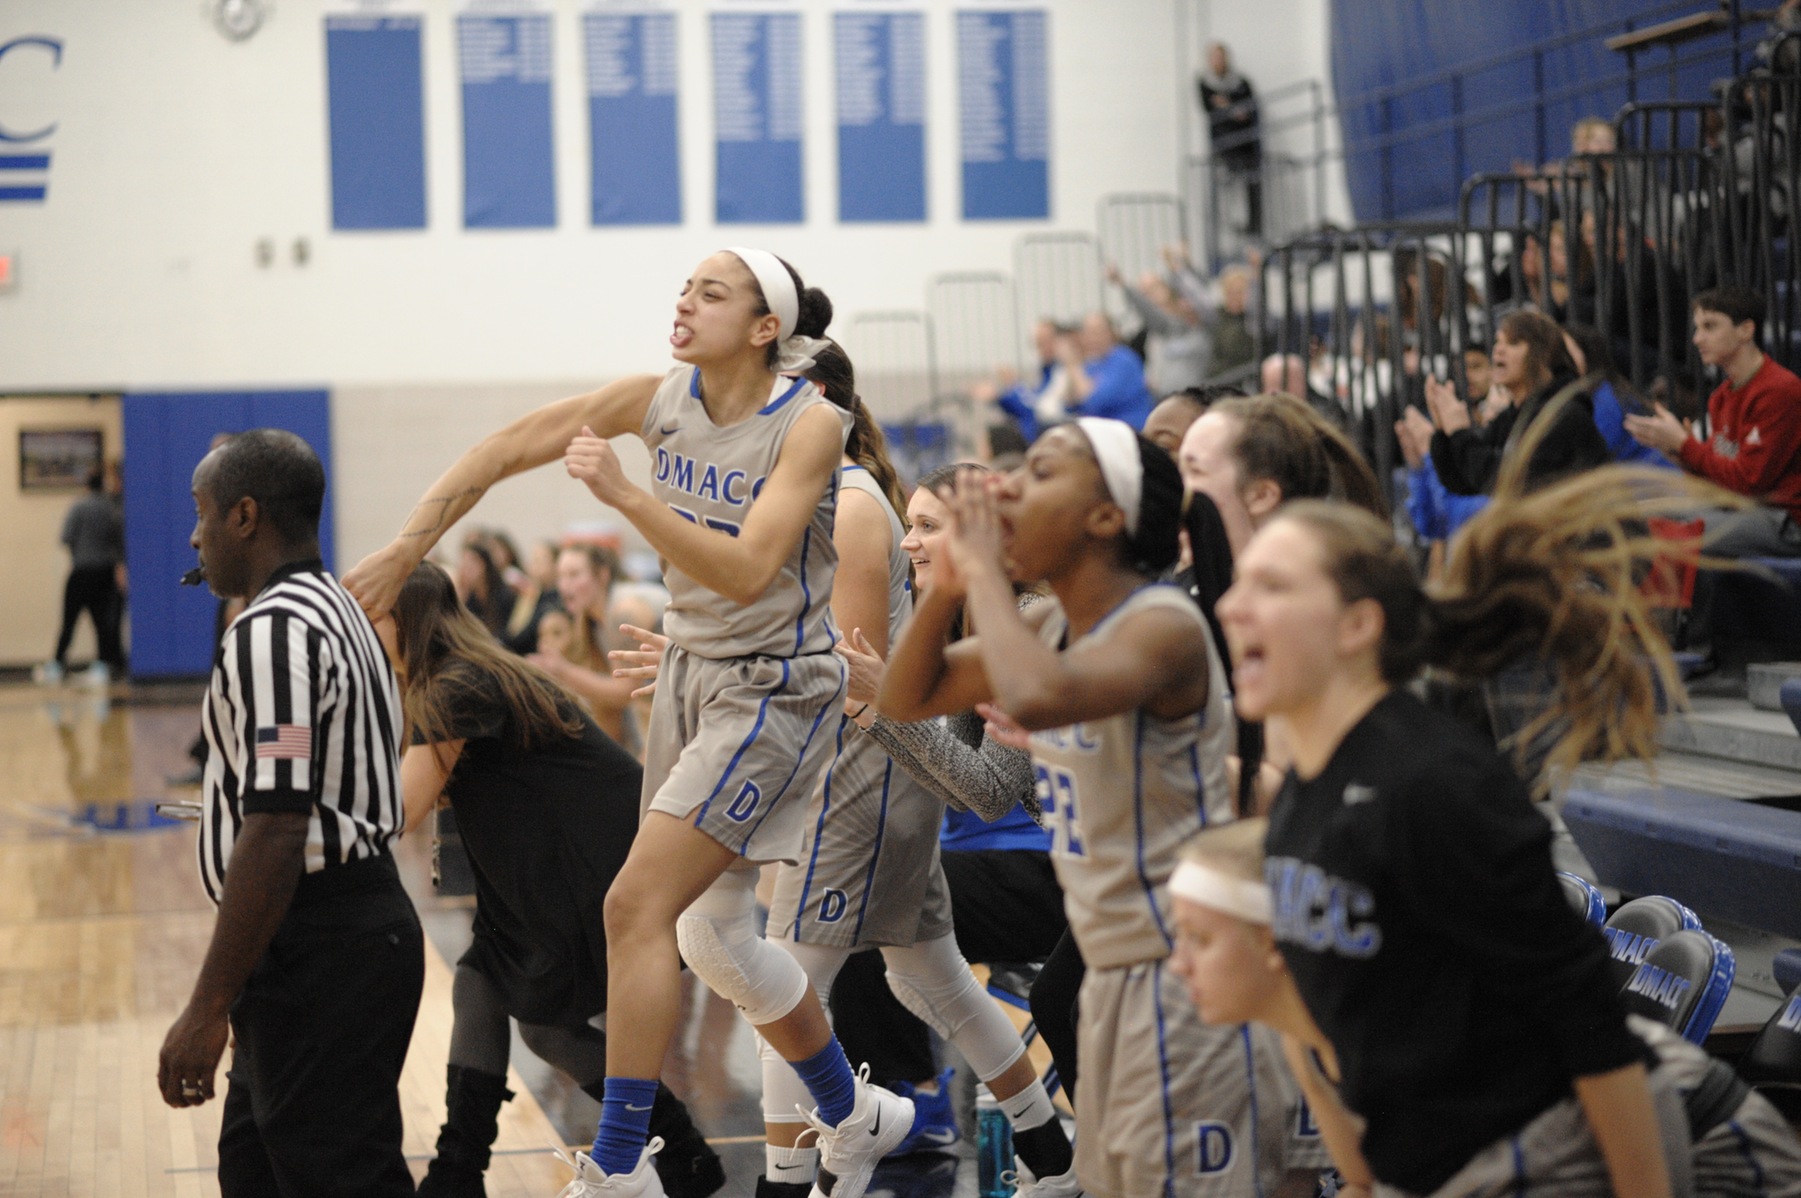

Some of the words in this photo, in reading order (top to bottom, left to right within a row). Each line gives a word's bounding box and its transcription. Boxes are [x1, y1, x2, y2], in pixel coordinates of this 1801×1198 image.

[723, 777, 762, 824] D
[815, 887, 848, 924] D
[1627, 961, 1691, 1010] DMACC
[1192, 1119, 1238, 1179] D
